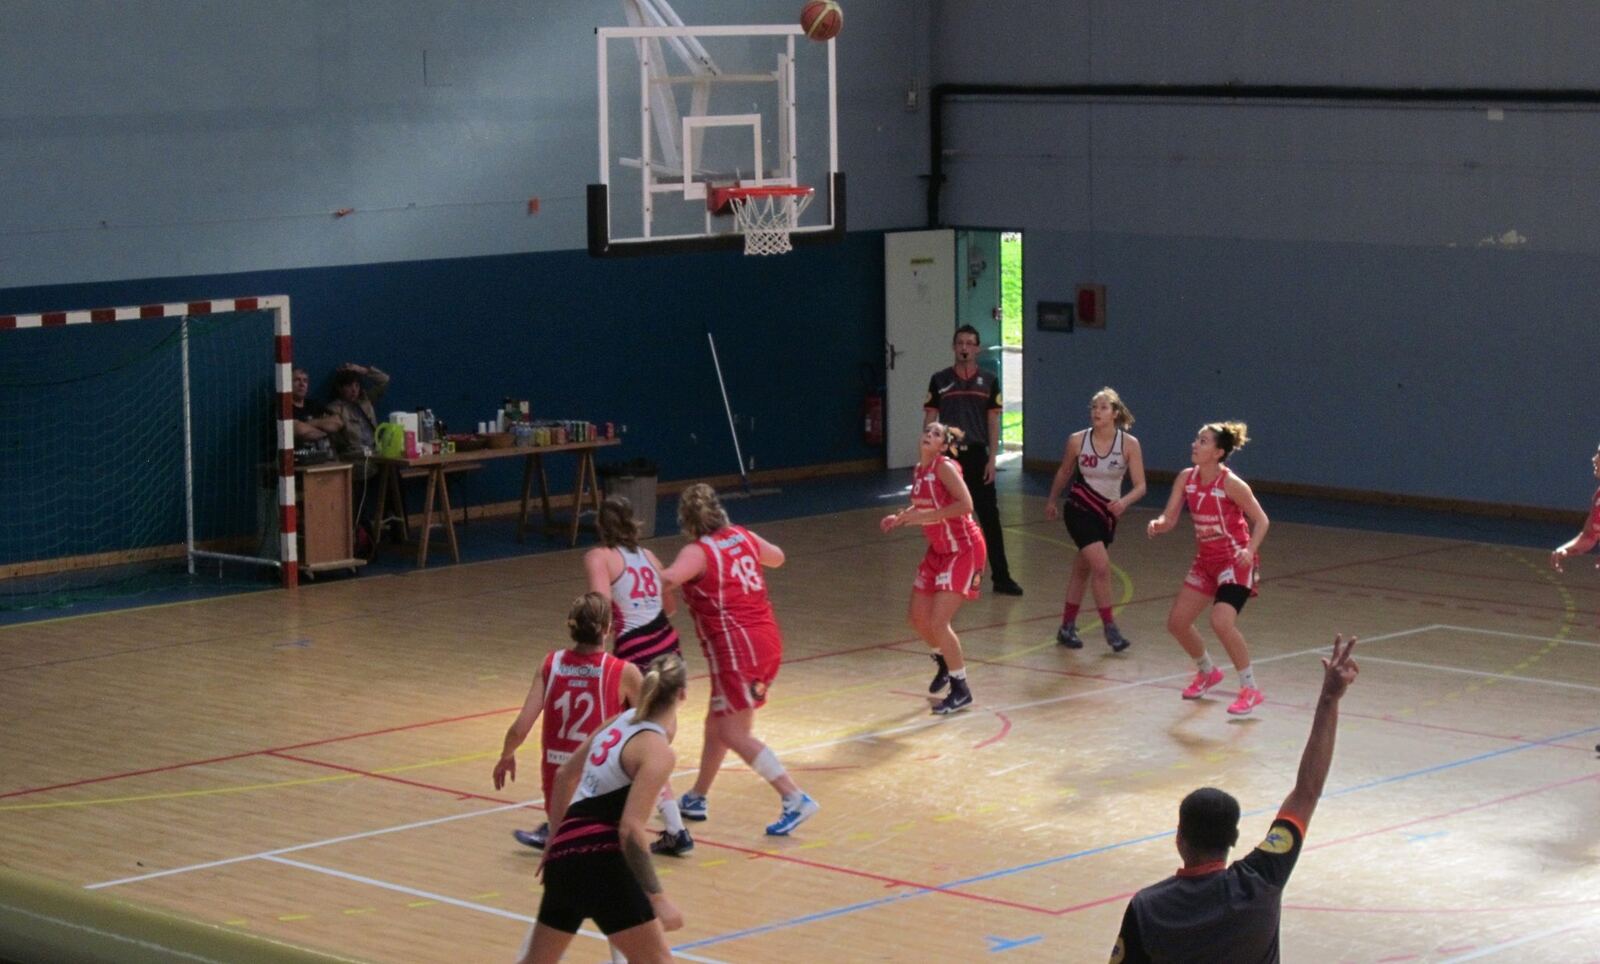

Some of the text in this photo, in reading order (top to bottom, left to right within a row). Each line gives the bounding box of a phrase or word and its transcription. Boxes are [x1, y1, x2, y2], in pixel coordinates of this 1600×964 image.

[1080, 454, 1098, 468] 20
[1197, 492, 1206, 511] 7
[627, 566, 657, 599] 28
[731, 555, 762, 595] 18
[554, 690, 594, 741] 12
[591, 728, 623, 767] 3
